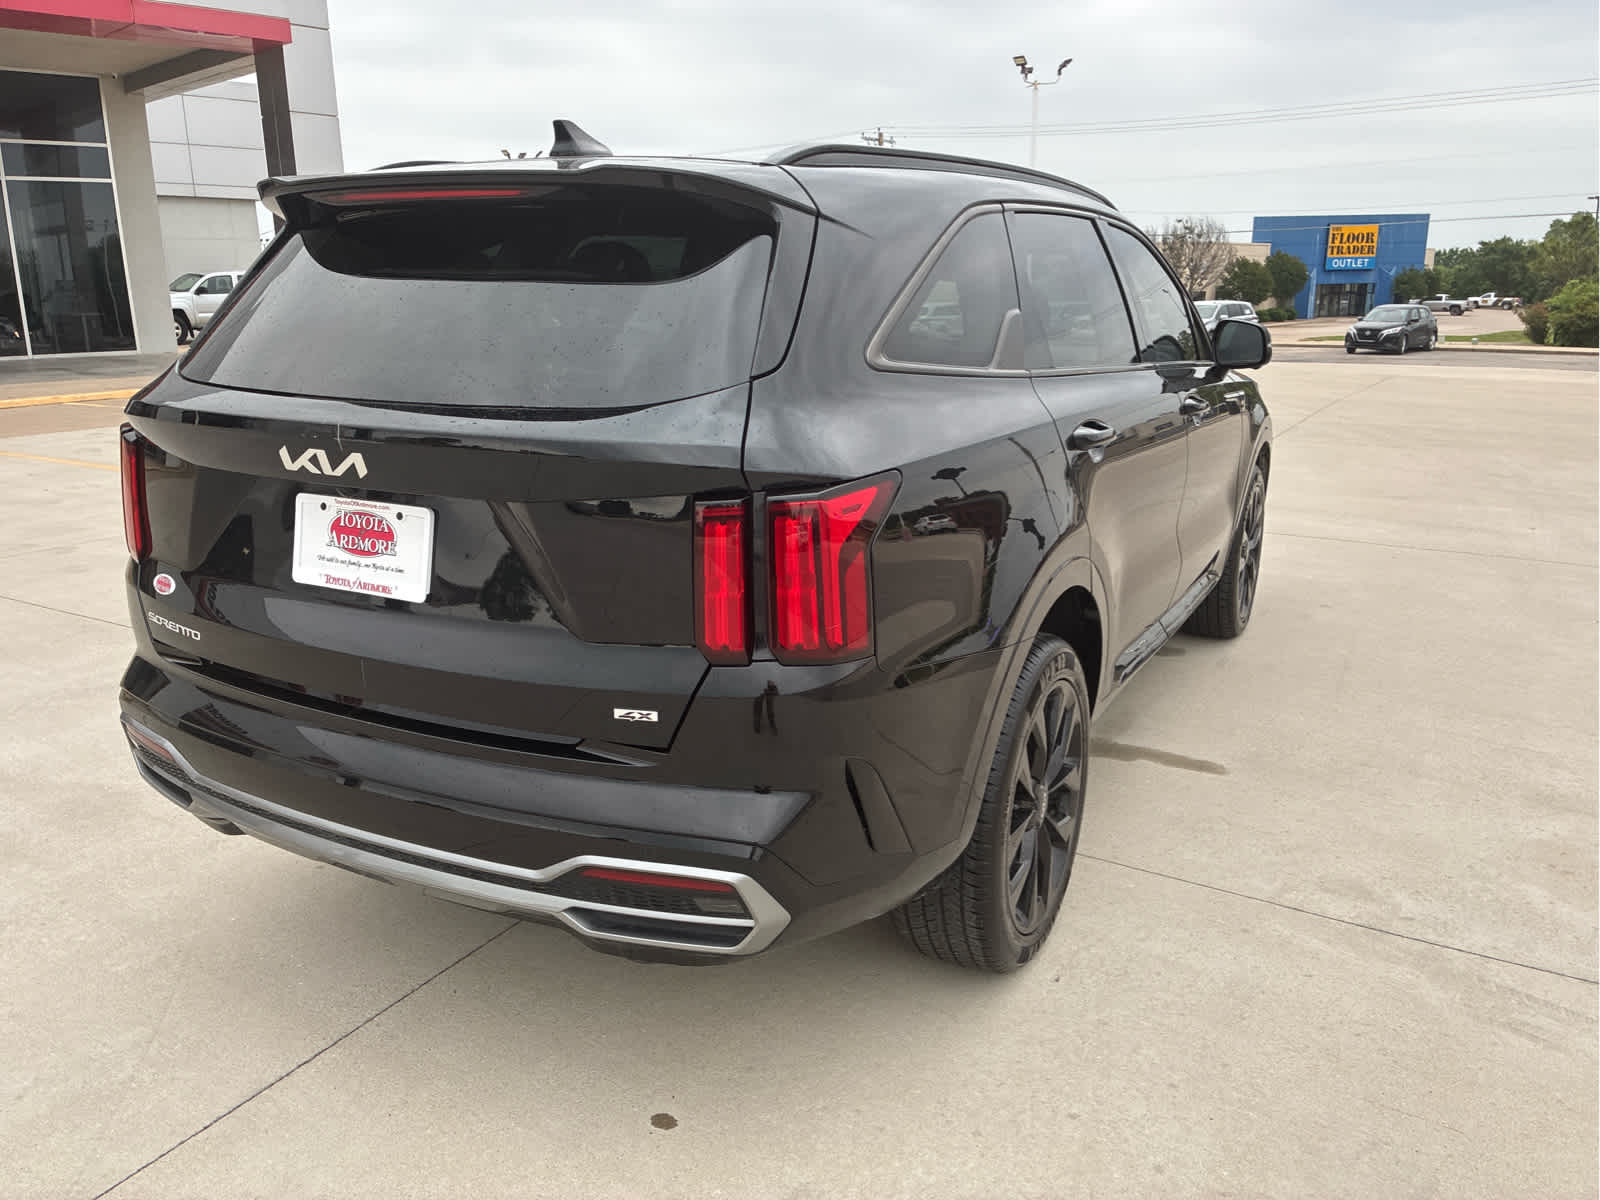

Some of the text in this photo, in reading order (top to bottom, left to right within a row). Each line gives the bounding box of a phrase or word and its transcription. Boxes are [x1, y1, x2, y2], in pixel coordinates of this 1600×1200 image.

[1331, 232, 1375, 244] FLOOR
[1329, 245, 1375, 255] TRADER
[1332, 258, 1369, 268] OUTLET
[278, 445, 368, 479] KIA
[337, 510, 390, 533] TOYOTA
[328, 530, 397, 556] ARDMORE
[324, 574, 351, 587] TOYOTA
[356, 580, 393, 594] ARDMORE
[148, 611, 201, 640] SORENTO
